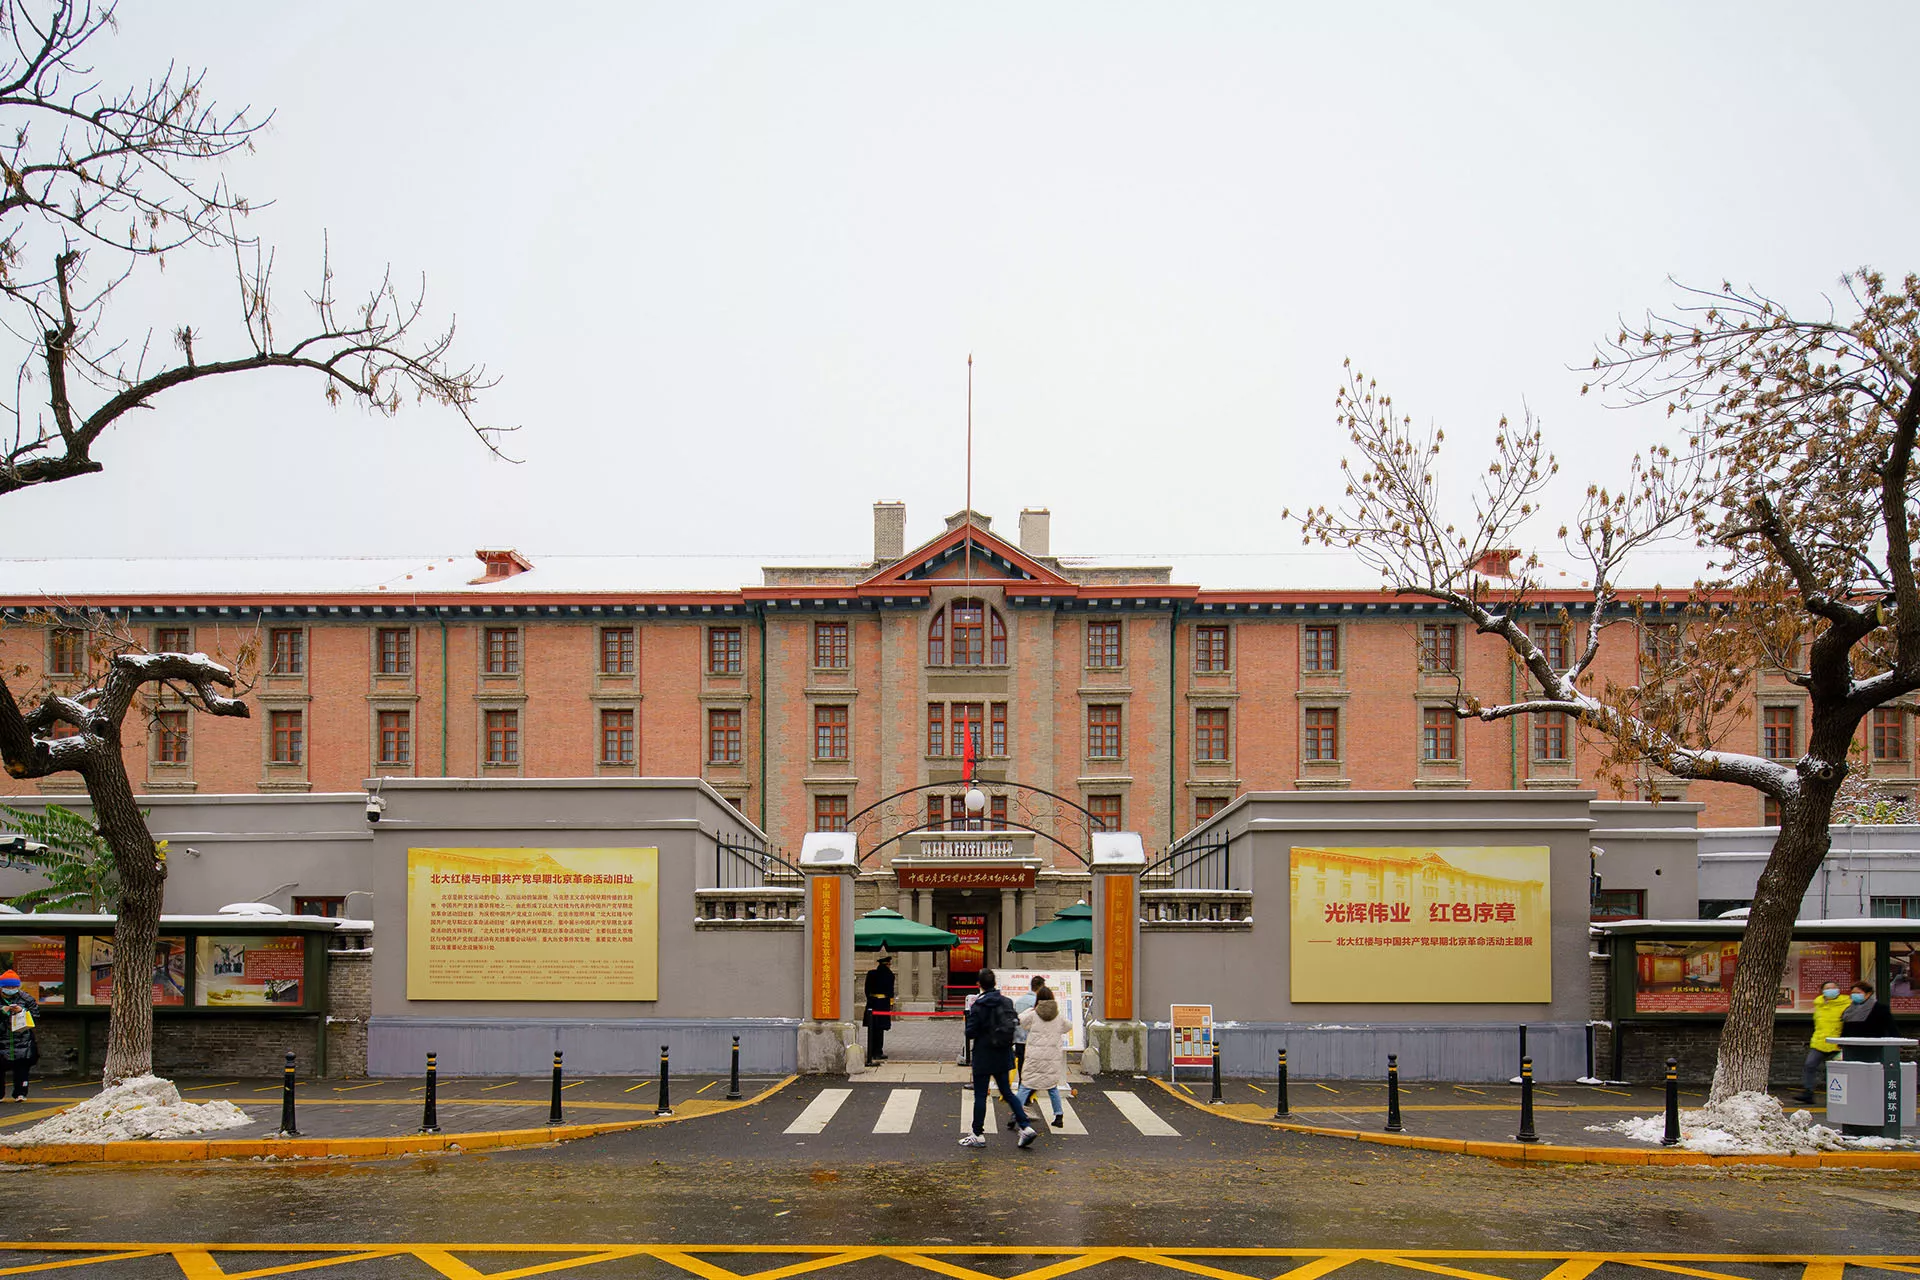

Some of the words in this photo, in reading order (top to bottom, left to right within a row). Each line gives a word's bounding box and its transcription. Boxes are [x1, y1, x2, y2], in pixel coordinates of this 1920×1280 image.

[430, 873, 634, 885] 北大红楼与中国共产党早期北京革命活动旧址
[1324, 902, 1411, 923] 光辉伟业
[1429, 902, 1517, 923] 红色序章
[821, 882, 832, 1014] 中国共产党早期北京革命活动纪念馆
[1112, 888, 1125, 1008] 北京新文化运动纪念馆
[1887, 1079, 1898, 1123] 东城环卫
